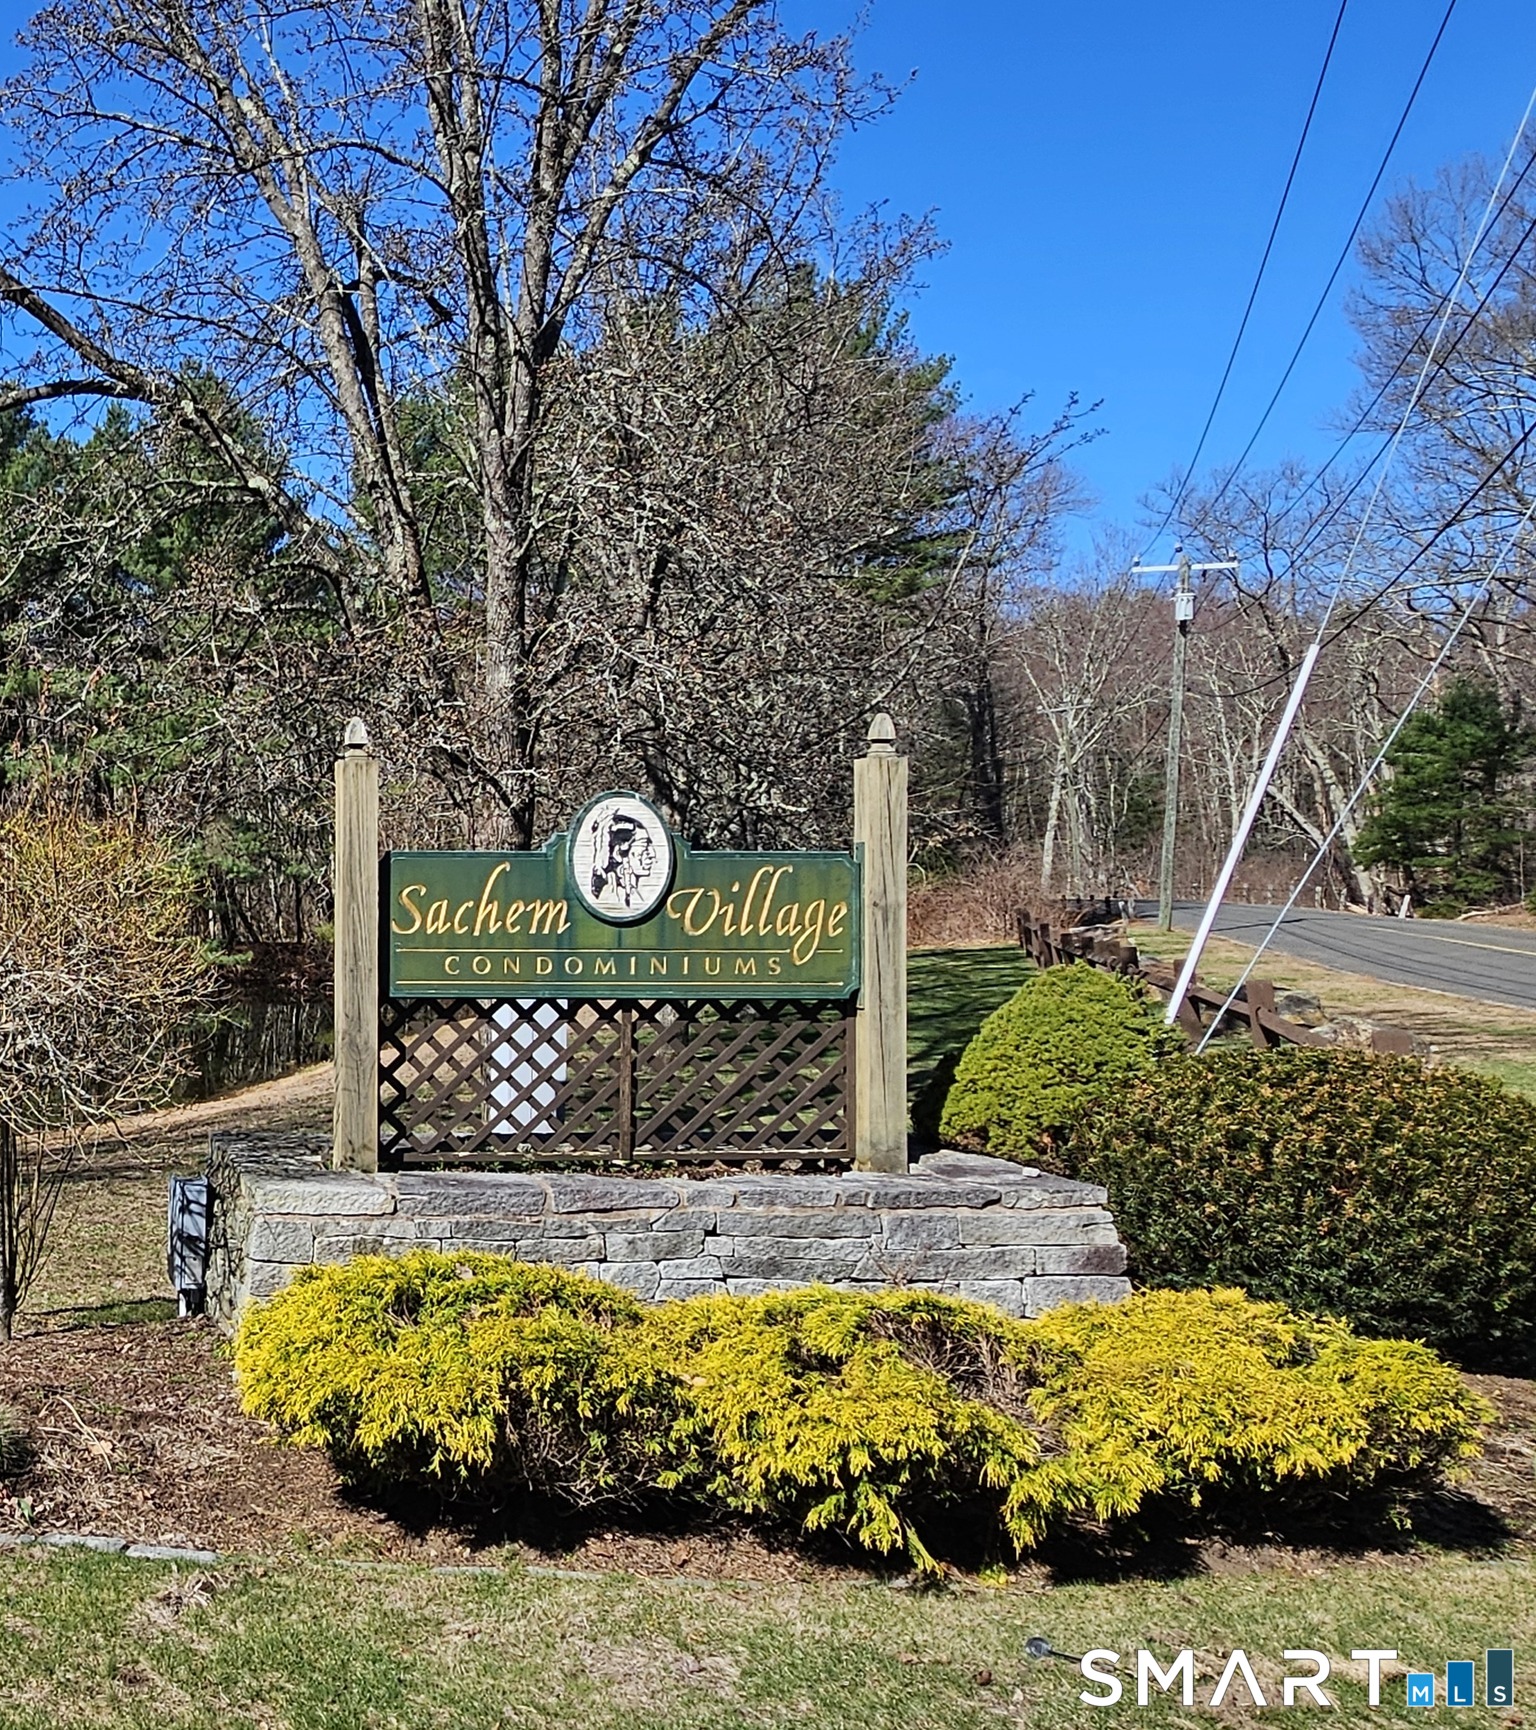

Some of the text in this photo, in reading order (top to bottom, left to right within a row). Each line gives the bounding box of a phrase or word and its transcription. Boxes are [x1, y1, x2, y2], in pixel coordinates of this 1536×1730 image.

[392, 861, 848, 966] Sachem Village
[444, 956, 782, 976] CONDOMINIUMS
